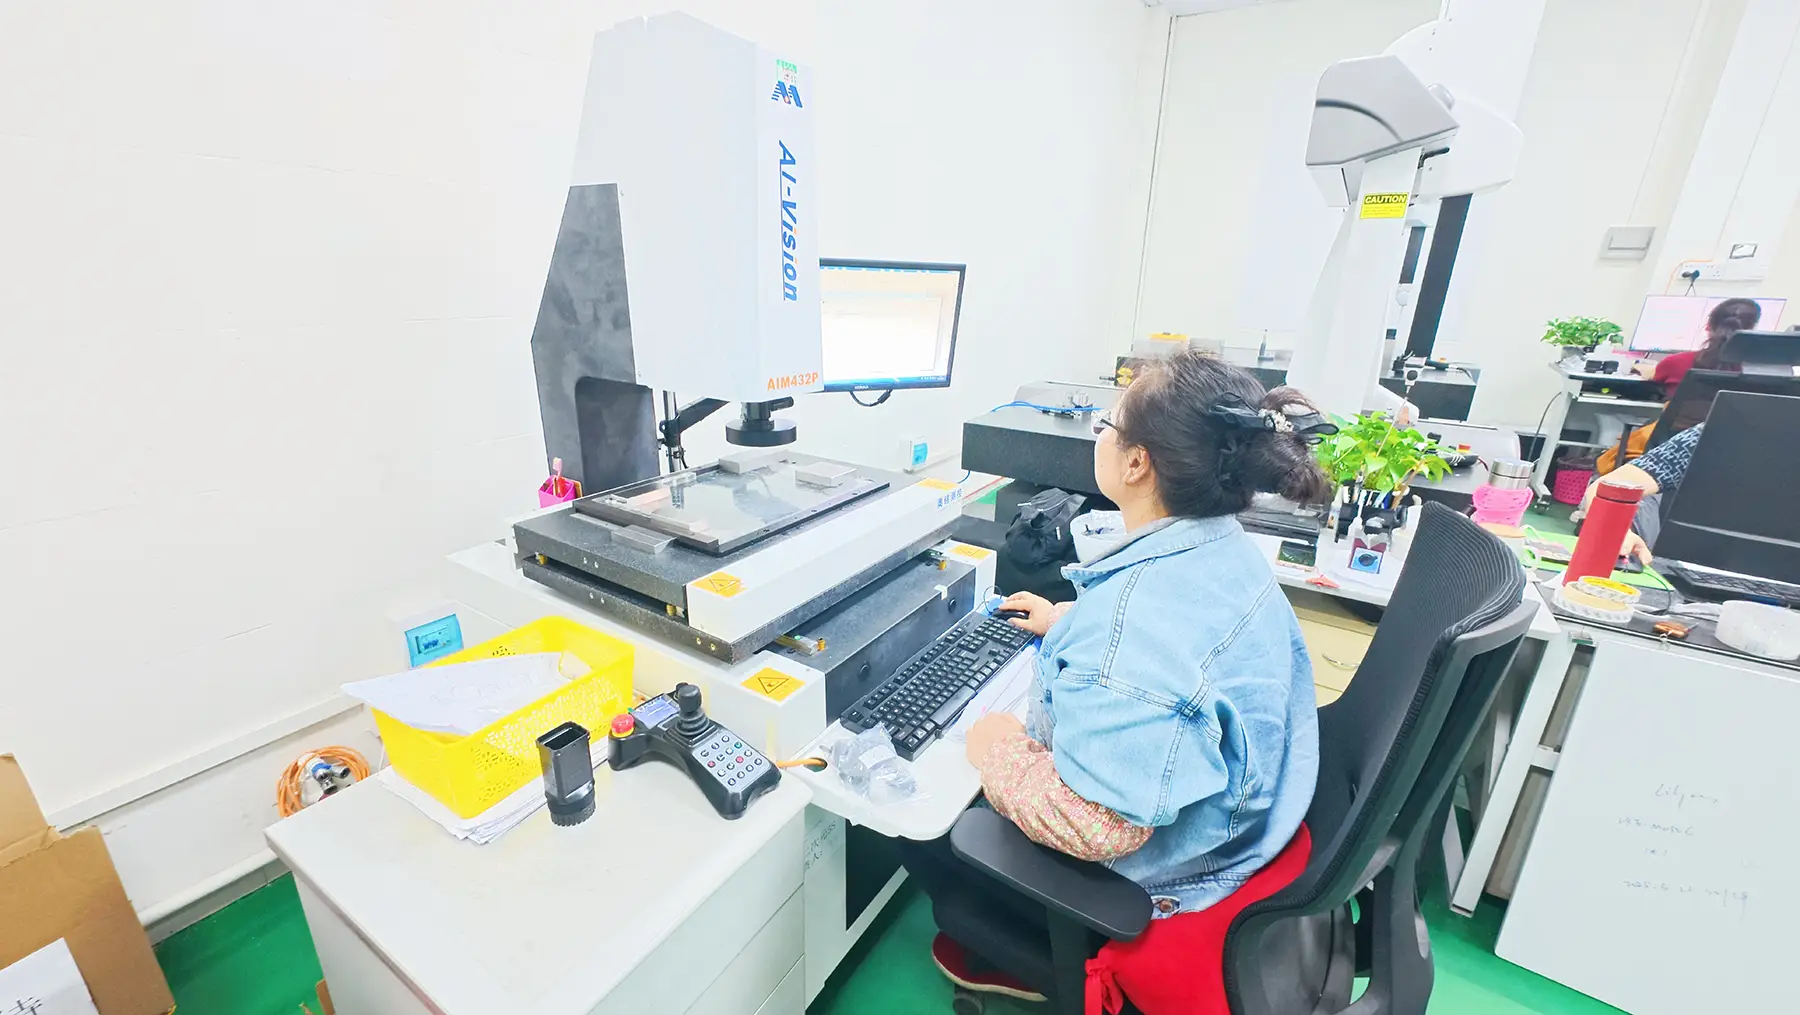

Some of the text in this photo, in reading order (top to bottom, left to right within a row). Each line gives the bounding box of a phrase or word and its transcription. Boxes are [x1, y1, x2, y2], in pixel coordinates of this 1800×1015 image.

[1365, 195, 1406, 204] CAUTION
[779, 139, 798, 301] AI-Vision
[767, 371, 819, 391] AIM432P
